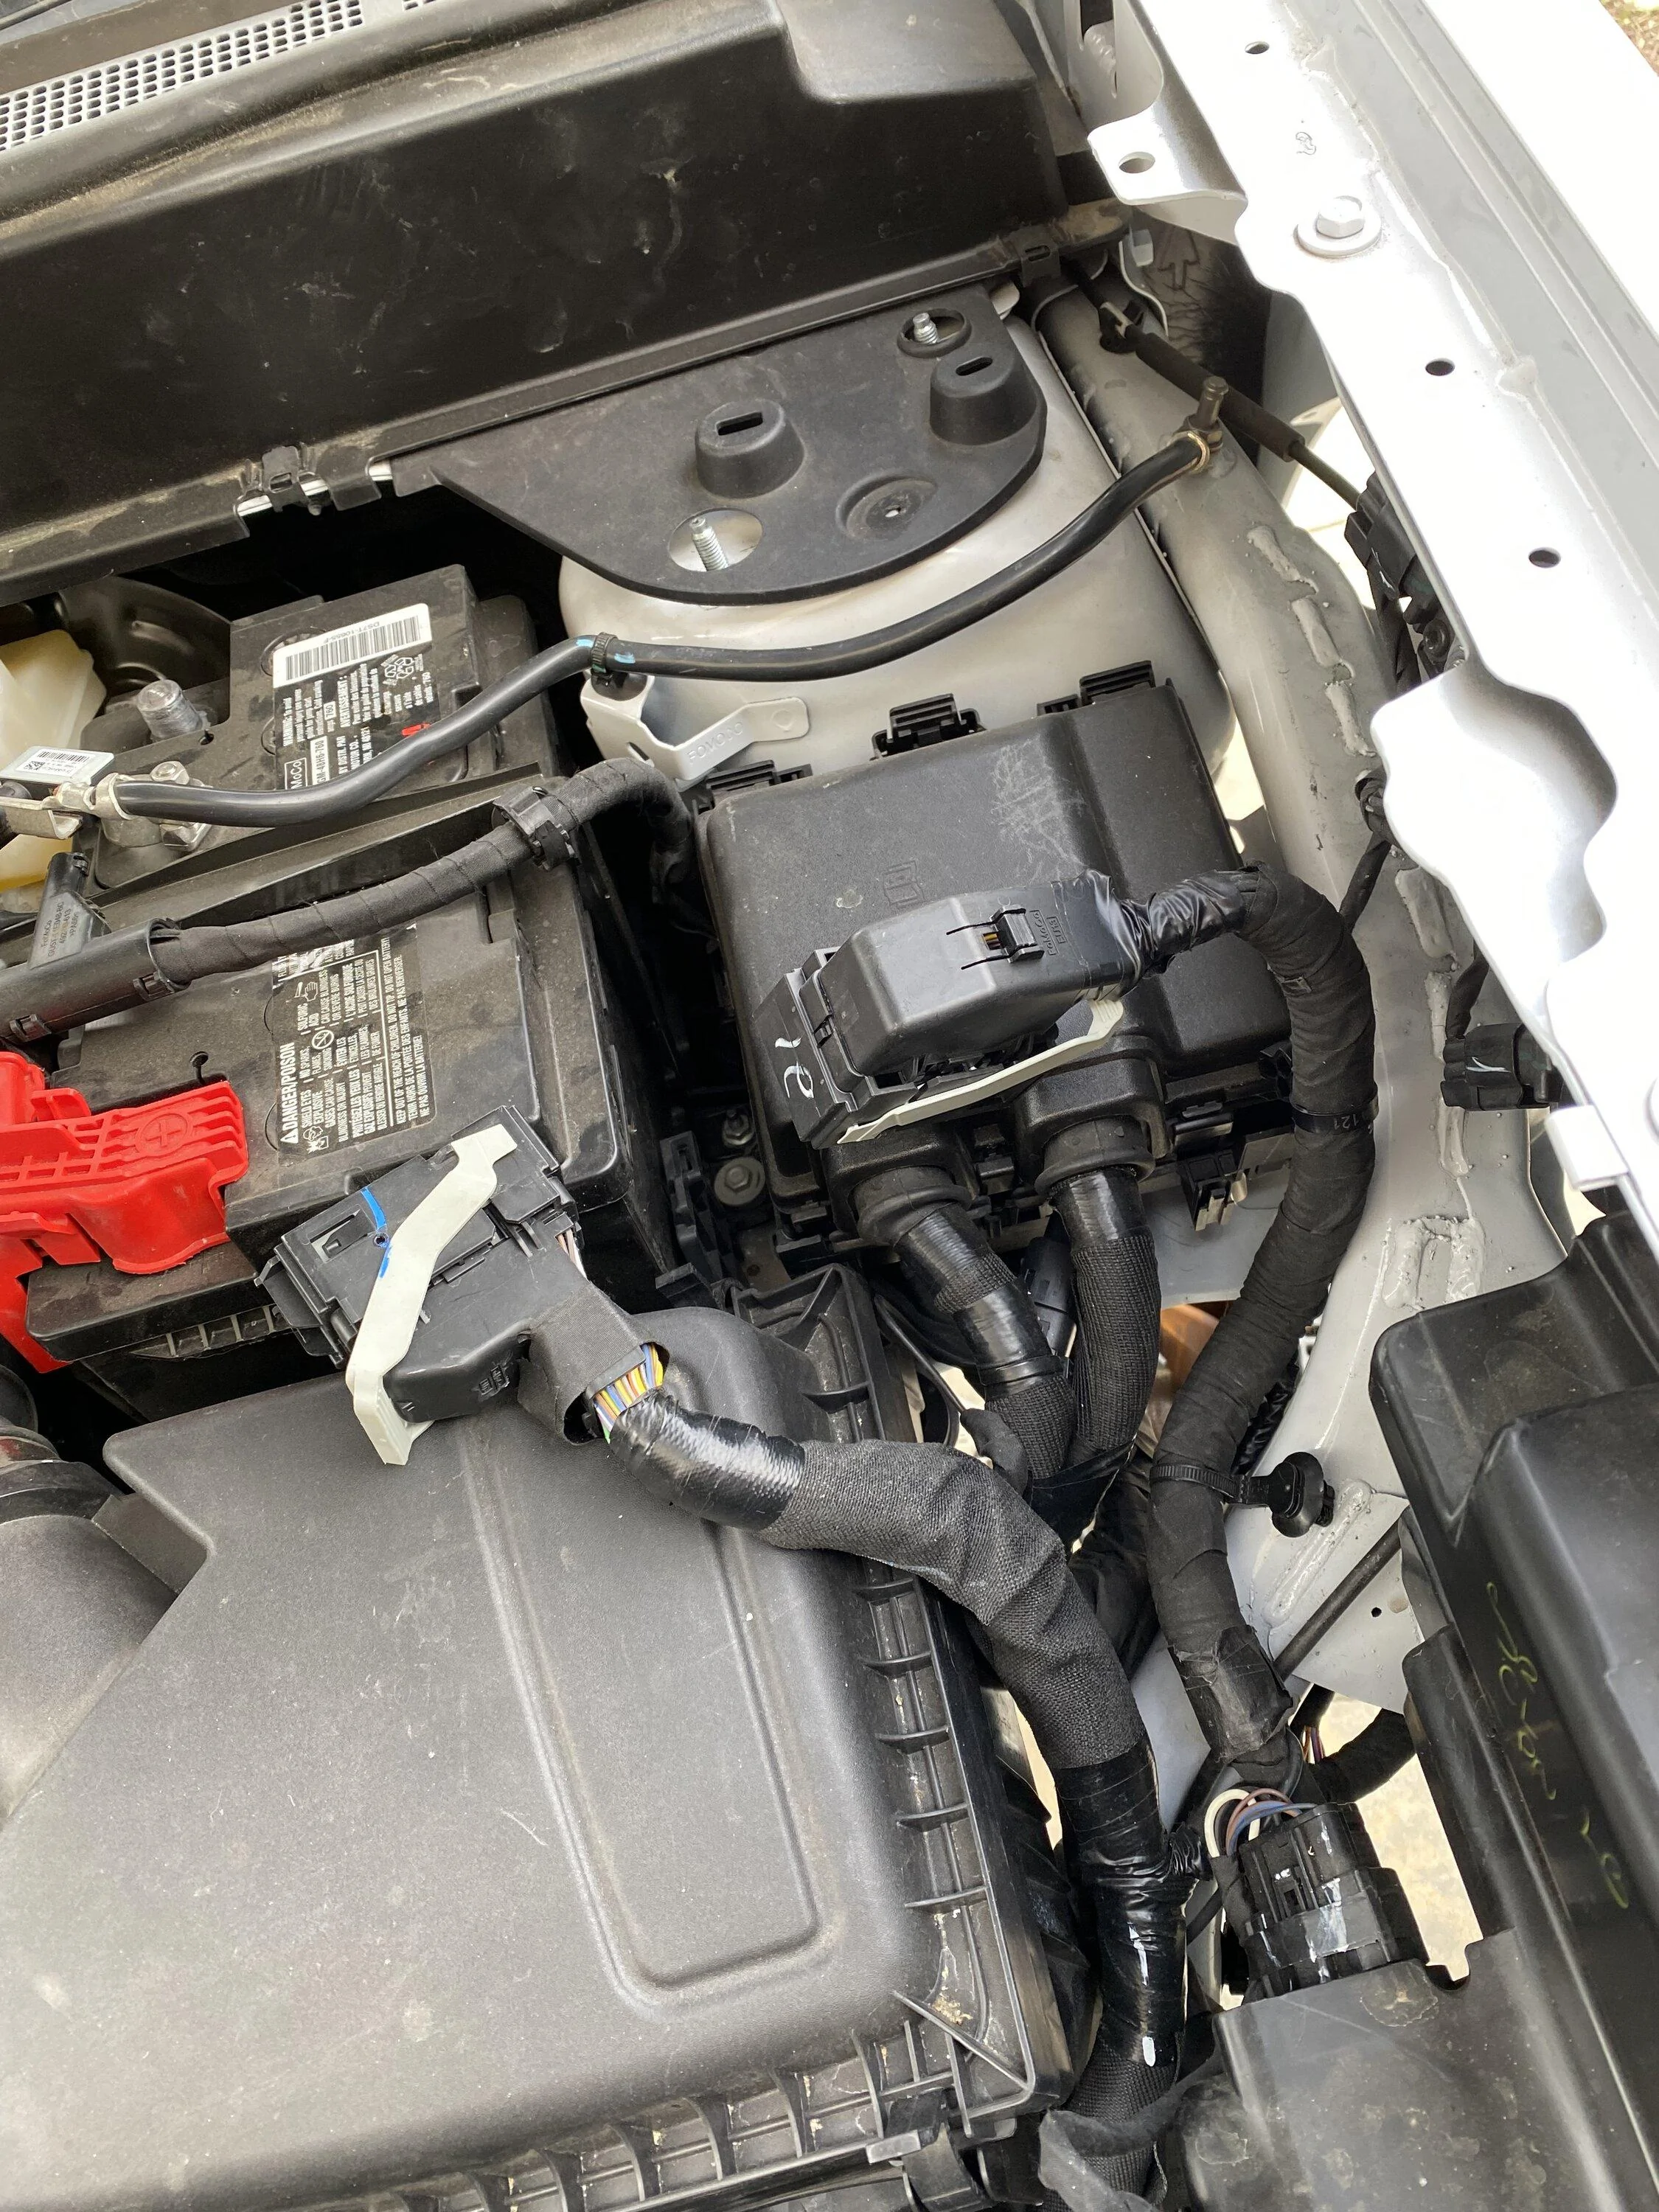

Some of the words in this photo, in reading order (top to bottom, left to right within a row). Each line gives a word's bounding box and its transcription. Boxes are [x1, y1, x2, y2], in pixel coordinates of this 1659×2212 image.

[326, 704, 334, 717] 760
[282, 715, 294, 746] WARNING:
[381, 937, 392, 961] BATTERY!
[366, 959, 376, 977] GRAVES
[383, 960, 393, 974] OPEN
[394, 954, 406, 988] RENVERSER.
[319, 970, 330, 998] BLINDNESS
[330, 974, 340, 993] BURNS
[343, 964, 355, 996] SULFURIQUE
[385, 973, 394, 985] NOT
[357, 985, 366, 1003] CAUSER
[386, 984, 394, 993] DO
[397, 987, 406, 999] PAS
[321, 997, 330, 1014] CAUSE
[332, 992, 341, 1012] SEVERE
[345, 995, 357, 1018] L'ACIDE
[358, 1001, 367, 1014] PEUT
[369, 1000, 379, 1010] DES
[387, 1003, 397, 1015] NOT
[398, 998, 407, 1007] NE
[298, 1004, 309, 1032] SULFURIC
[309, 1013, 320, 1028] ACID
[321, 1013, 331, 1025] CAN
[333, 1011, 342, 1021] OR
[388, 1014, 397, 1023] DO
[399, 1006, 410, 1034] ENFANTS.
[336, 1037, 347, 1048] LES
[371, 1032, 381, 1049] FUMER
[389, 1023, 400, 1052] CHILDREN.
[402, 1034, 411, 1046] DES
[299, 1046, 311, 1070] SPARKS,
[361, 1050, 371, 1060] LES
[372, 1048, 382, 1057] DE
[392, 1051, 401, 1060] OF
[414, 1035, 425, 1065] BATTERIE!
[312, 1053, 323, 1075] FLAMES,
[323, 1048, 333, 1071] SMOKING
[299, 1069, 311, 1079] NO
[349, 1069, 361, 1081] LES
[373, 1063, 384, 1084] AVEUGLE
[392, 1059, 403, 1078] REACH
[405, 1068, 414, 1077] LA
[417, 1064, 425, 1073] LA
[280, 1043, 298, 1131] DANGER/POISON
[324, 1078, 335, 1096] CAUSE
[350, 1080, 361, 1097] YEUX
[362, 1071, 372, 1094] PEUVENT
[394, 1077, 404, 1089] THE
[406, 1076, 415, 1085] DE
[417, 1072, 428, 1096] OUVRIR
[301, 1090, 312, 1107] EYES
[336, 1082, 347, 1103] INJURY
[375, 1083, 386, 1102] RENDRE
[394, 1088, 405, 1098] OF
[406, 1085, 417, 1102] HORS
[313, 1091, 325, 1125] EXPLOSIVE
[326, 1096, 335, 1108] CAN
[338, 1102, 347, 1111] OR
[351, 1096, 363, 1108] LES
[362, 1093, 375, 1123] EXPLOSIFS
[376, 1102, 386, 1110] OU
[395, 1097, 406, 1110] OUT
[420, 1095, 429, 1108] PAS
[301, 1106, 313, 1128] SHIELD
[324, 1108, 336, 1128] GASES
[396, 1109, 407, 1124] KEEP
[408, 1102, 419, 1121] TENIR
[420, 1107, 431, 1117] NE
[338, 1110, 349, 1142] BLINDNESS
[364, 1121, 376, 1135] GAZ
